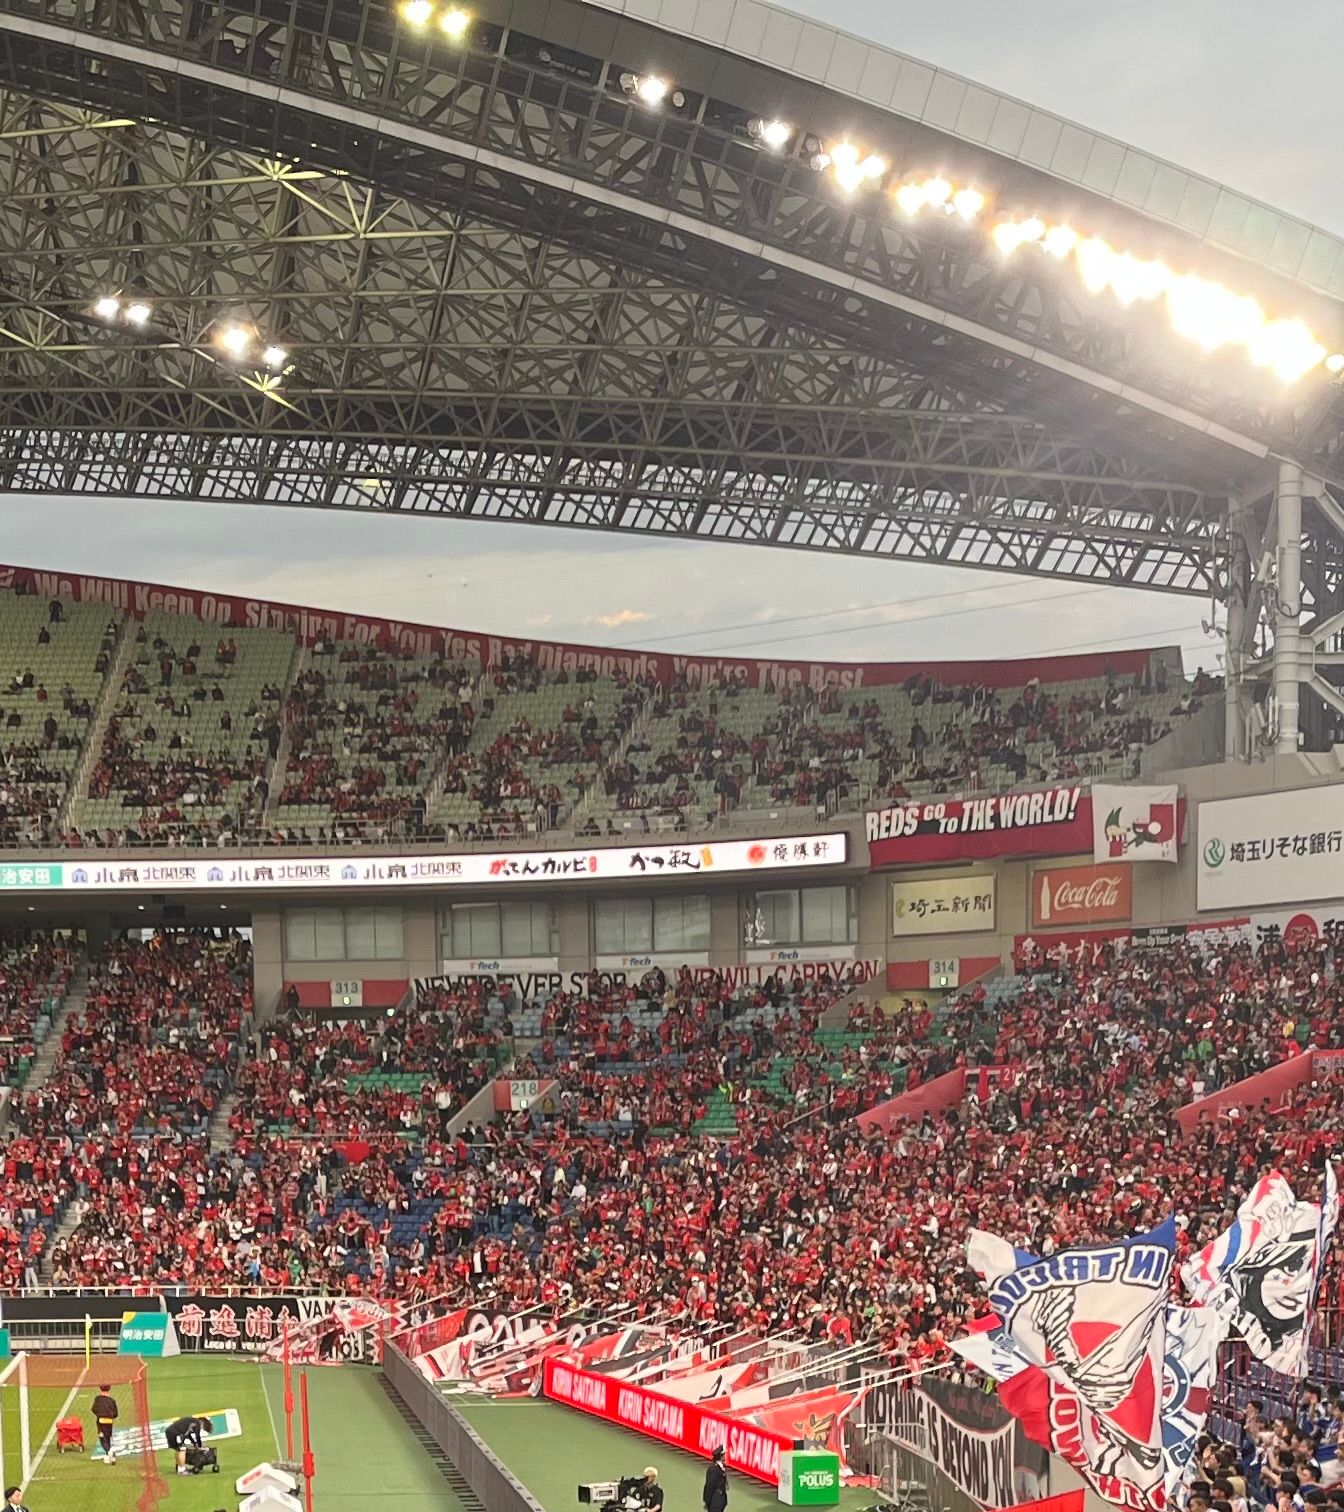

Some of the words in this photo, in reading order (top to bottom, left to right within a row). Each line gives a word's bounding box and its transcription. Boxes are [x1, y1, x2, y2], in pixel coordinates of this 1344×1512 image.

[866, 806, 918, 842] REDS
[924, 803, 946, 822] GO
[938, 816, 958, 834] TO
[960, 800, 995, 832] THE
[998, 788, 1080, 829] WORLD!
[1229, 830, 1343, 864] 埼玉りそな銀行
[908, 893, 994, 917] 埼玉新聞
[1055, 875, 1121, 909] Coca-Cola
[933, 961, 955, 974] 314
[335, 983, 359, 994] 313
[511, 1083, 538, 1096] 218
[122, 1329, 164, 1341] 明治安田
[552, 1367, 572, 1399] KIRIN
[573, 1374, 606, 1412] SAITAMA
[618, 1388, 642, 1422] KIRIN
[643, 1400, 684, 1440] SAITAMA
[699, 1416, 728, 1452] KIRIN
[729, 1425, 780, 1478] SAITAMA
[798, 1474, 834, 1488] POLUS
